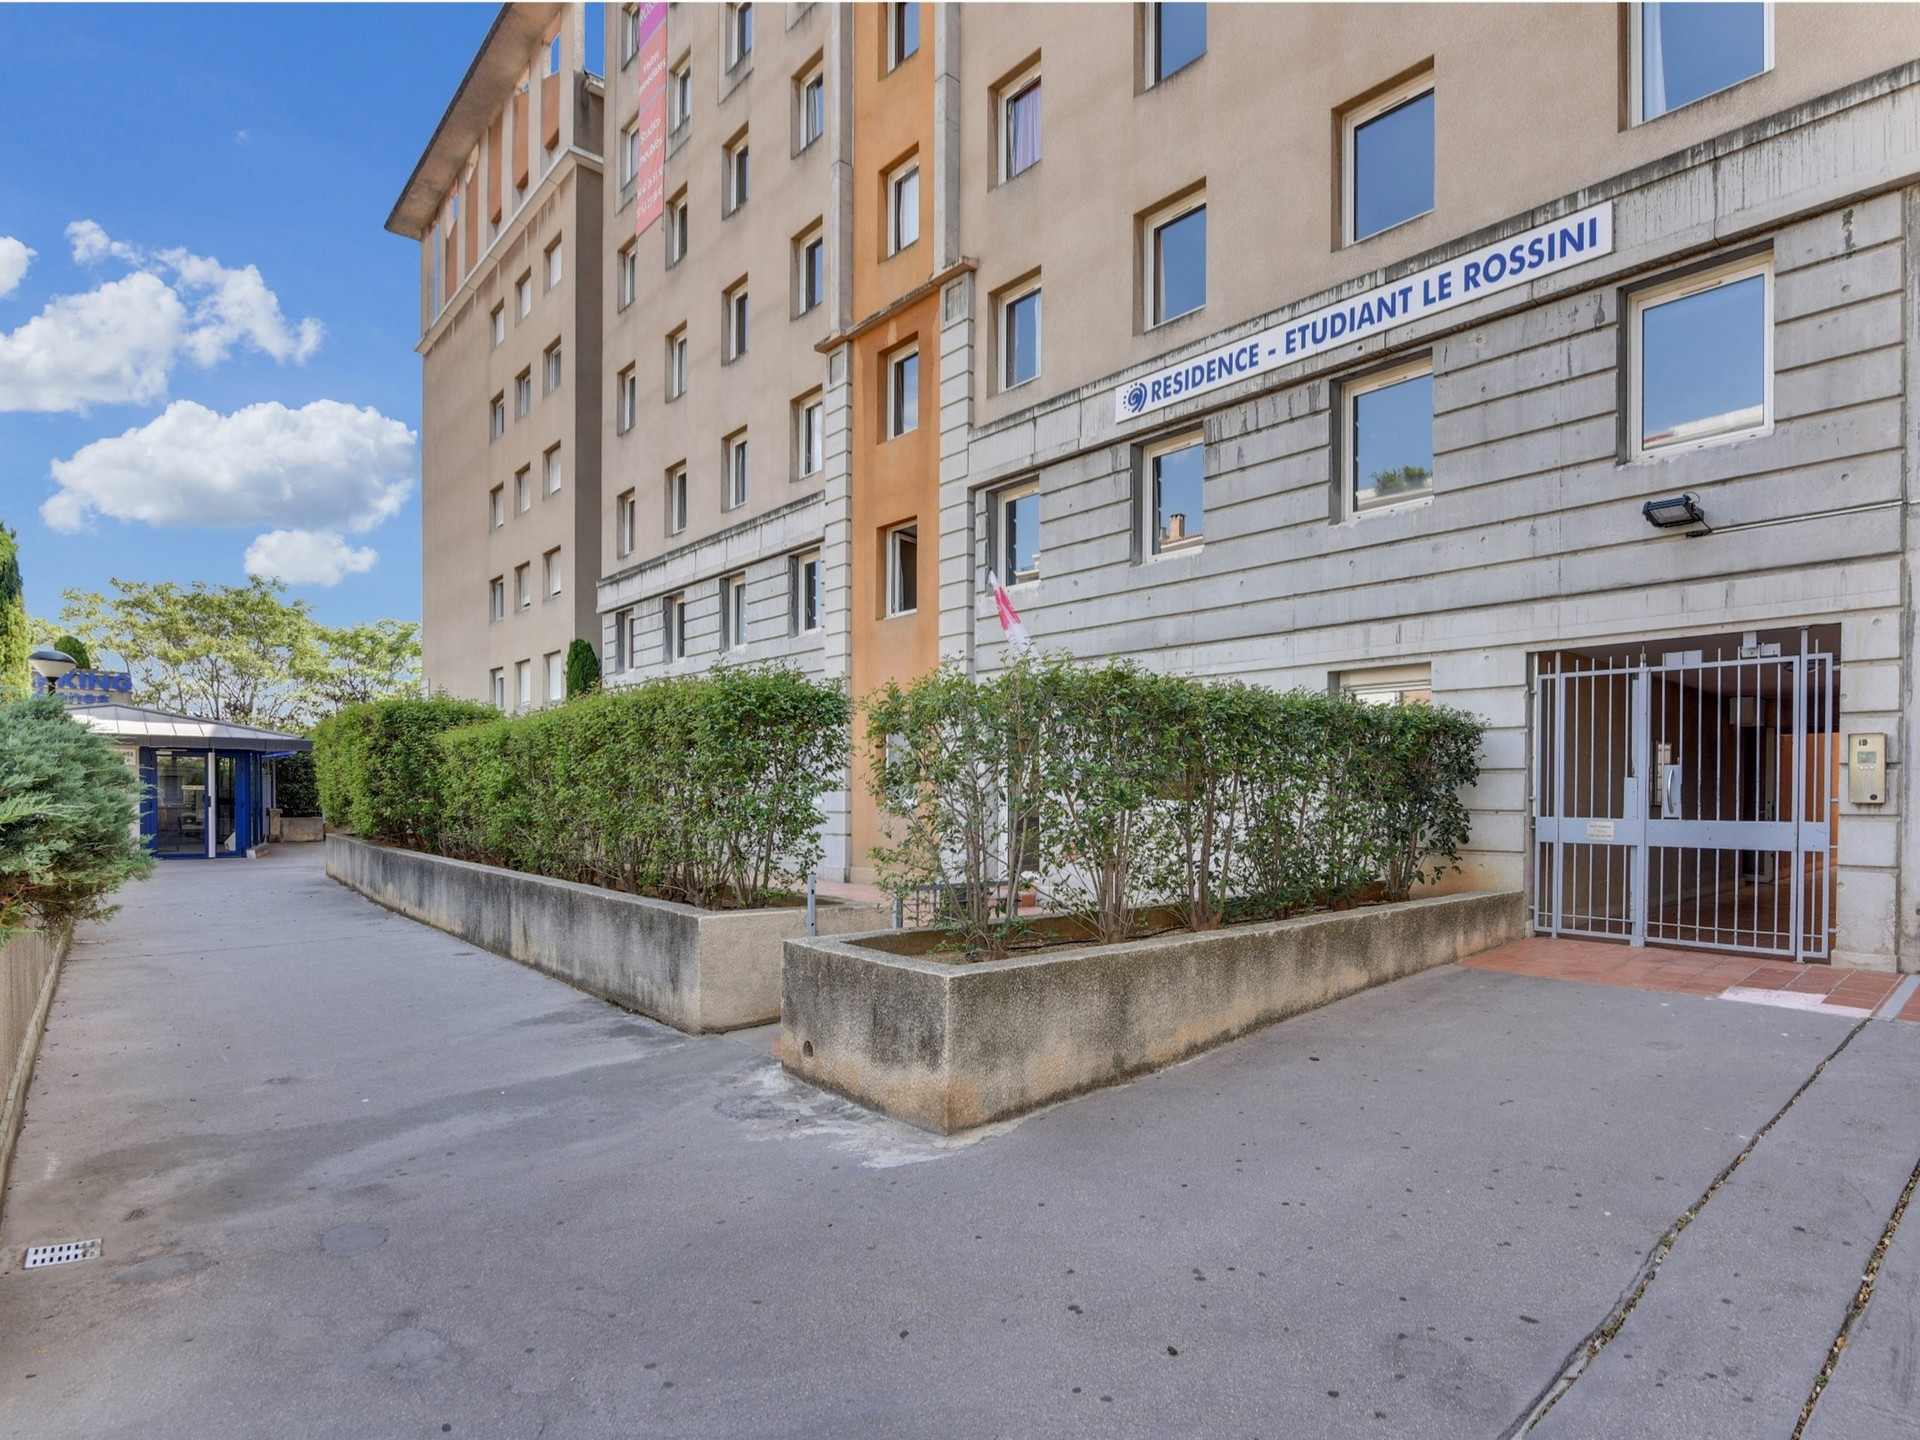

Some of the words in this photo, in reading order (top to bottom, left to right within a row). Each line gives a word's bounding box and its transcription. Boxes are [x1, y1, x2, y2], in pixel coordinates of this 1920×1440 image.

[640, 116, 661, 145] Studios
[1151, 343, 1259, 402] RESIDENCE
[1267, 347, 1277, 357] -
[1285, 286, 1413, 355] ETUDIANT
[1422, 271, 1452, 306] LE
[1463, 217, 1597, 293] ROSSINI
